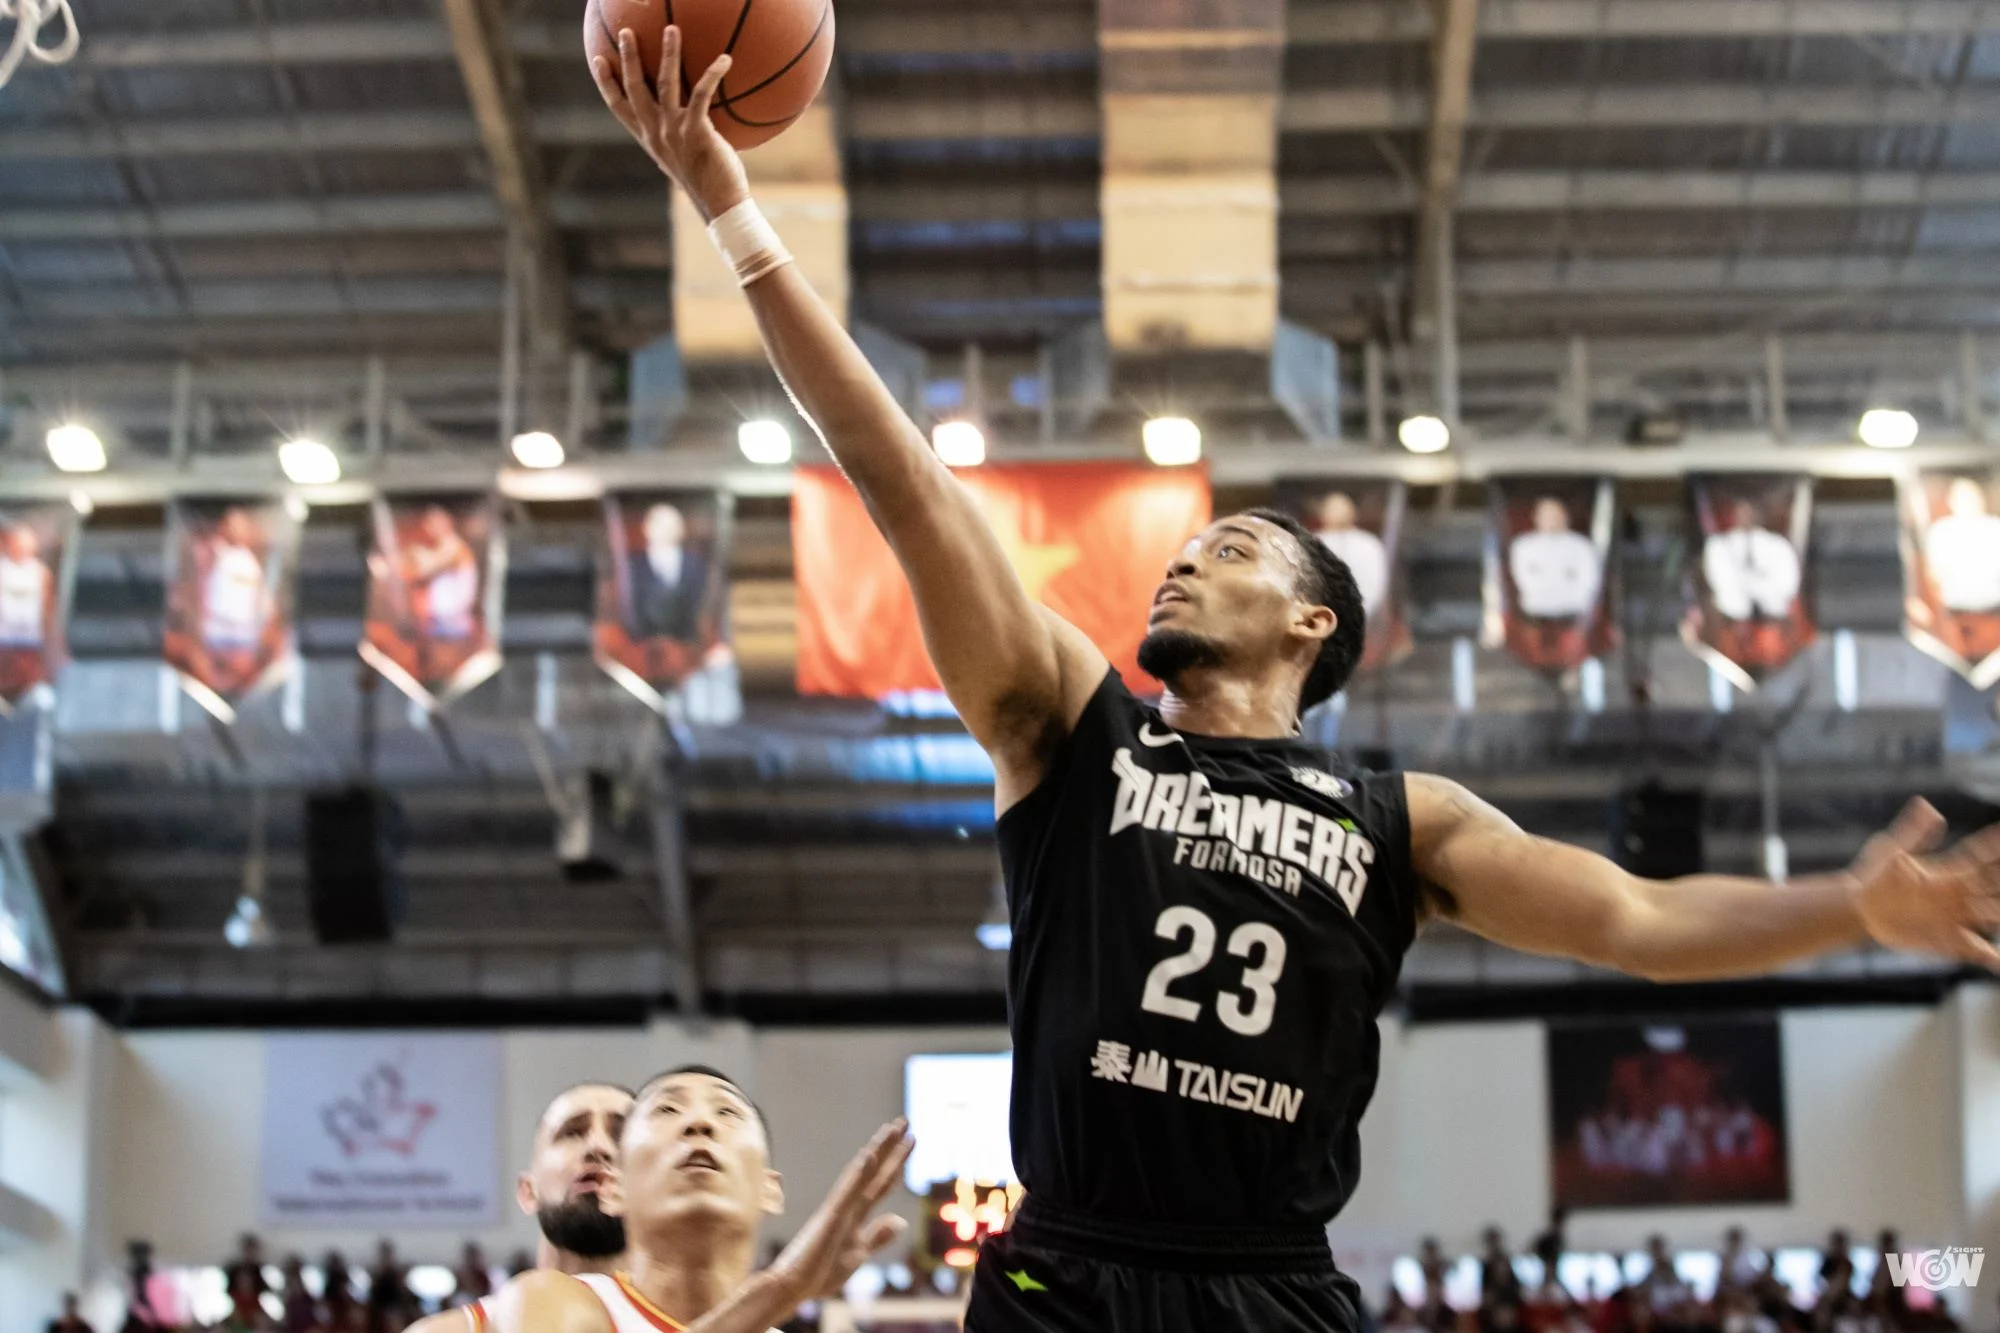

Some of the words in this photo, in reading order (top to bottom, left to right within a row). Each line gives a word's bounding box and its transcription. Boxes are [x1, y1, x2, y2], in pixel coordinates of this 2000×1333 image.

[1109, 747, 1376, 917] DREAMERS
[1173, 836, 1302, 897] FORMOSA
[1141, 905, 1287, 1036] 23
[1090, 1039, 1169, 1092] 泰山
[1174, 1059, 1304, 1123] TAISUN
